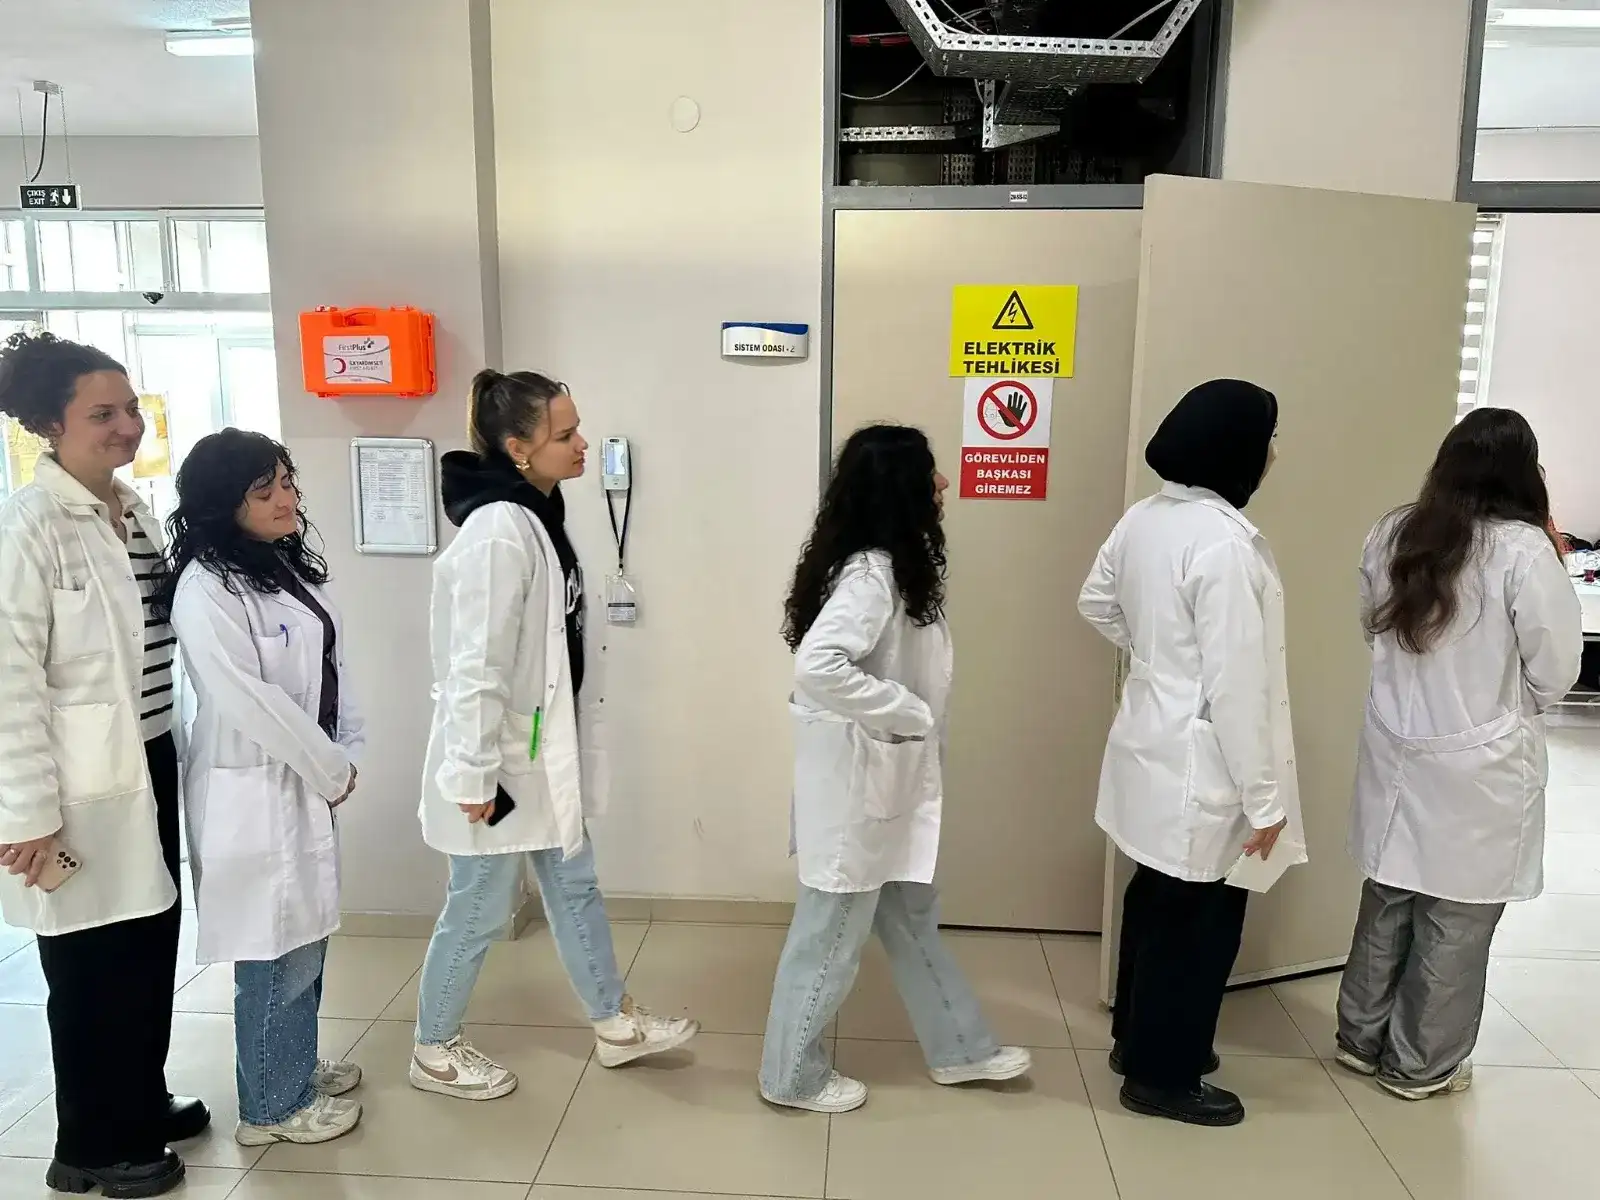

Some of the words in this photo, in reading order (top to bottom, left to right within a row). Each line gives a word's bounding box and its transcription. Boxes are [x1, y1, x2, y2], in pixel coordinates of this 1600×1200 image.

[26, 189, 46, 198] ÇIKIŞ
[338, 343, 366, 351] FirstPlus
[762, 344, 785, 352] ODASI
[790, 345, 796, 353] 2
[964, 339, 1056, 355] ELEKTRİK
[963, 358, 1060, 374] TEHLİKESİ
[964, 452, 1045, 464] GÖREVLİDEN
[976, 469, 1031, 480] BAŞKASI
[975, 483, 1032, 494] GİREMEZ
